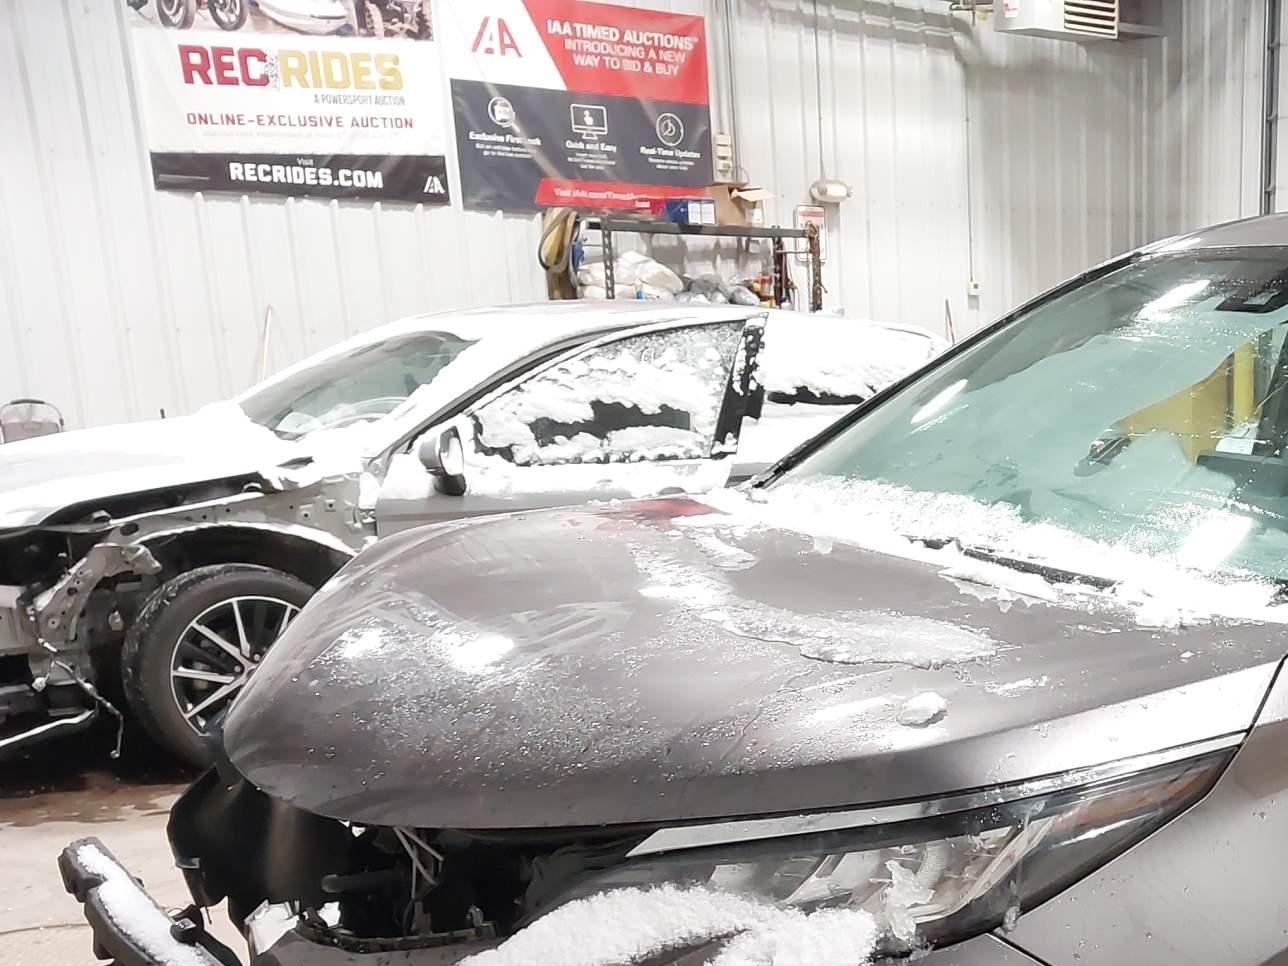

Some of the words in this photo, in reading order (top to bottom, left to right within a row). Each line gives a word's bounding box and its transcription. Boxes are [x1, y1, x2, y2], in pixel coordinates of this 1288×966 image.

[547, 19, 573, 37] IAA
[573, 22, 620, 42] TIMED
[564, 38, 646, 60] INTRODUCING
[647, 49, 657, 60] A
[658, 50, 687, 64] NEW
[178, 44, 269, 87] REC
[277, 50, 403, 91] RIDES
[572, 53, 600, 69] WAY
[602, 56, 621, 71] TO
[621, 59, 642, 73] BID
[642, 61, 653, 74] &
[655, 62, 680, 76] BUY
[320, 94, 373, 105] POWERSPORT
[374, 95, 405, 106] AUCTION
[186, 112, 344, 129] ONLINE-EXCLUSIVE
[350, 116, 414, 130] AUCTION
[229, 163, 383, 189] RECRIDES.COM
